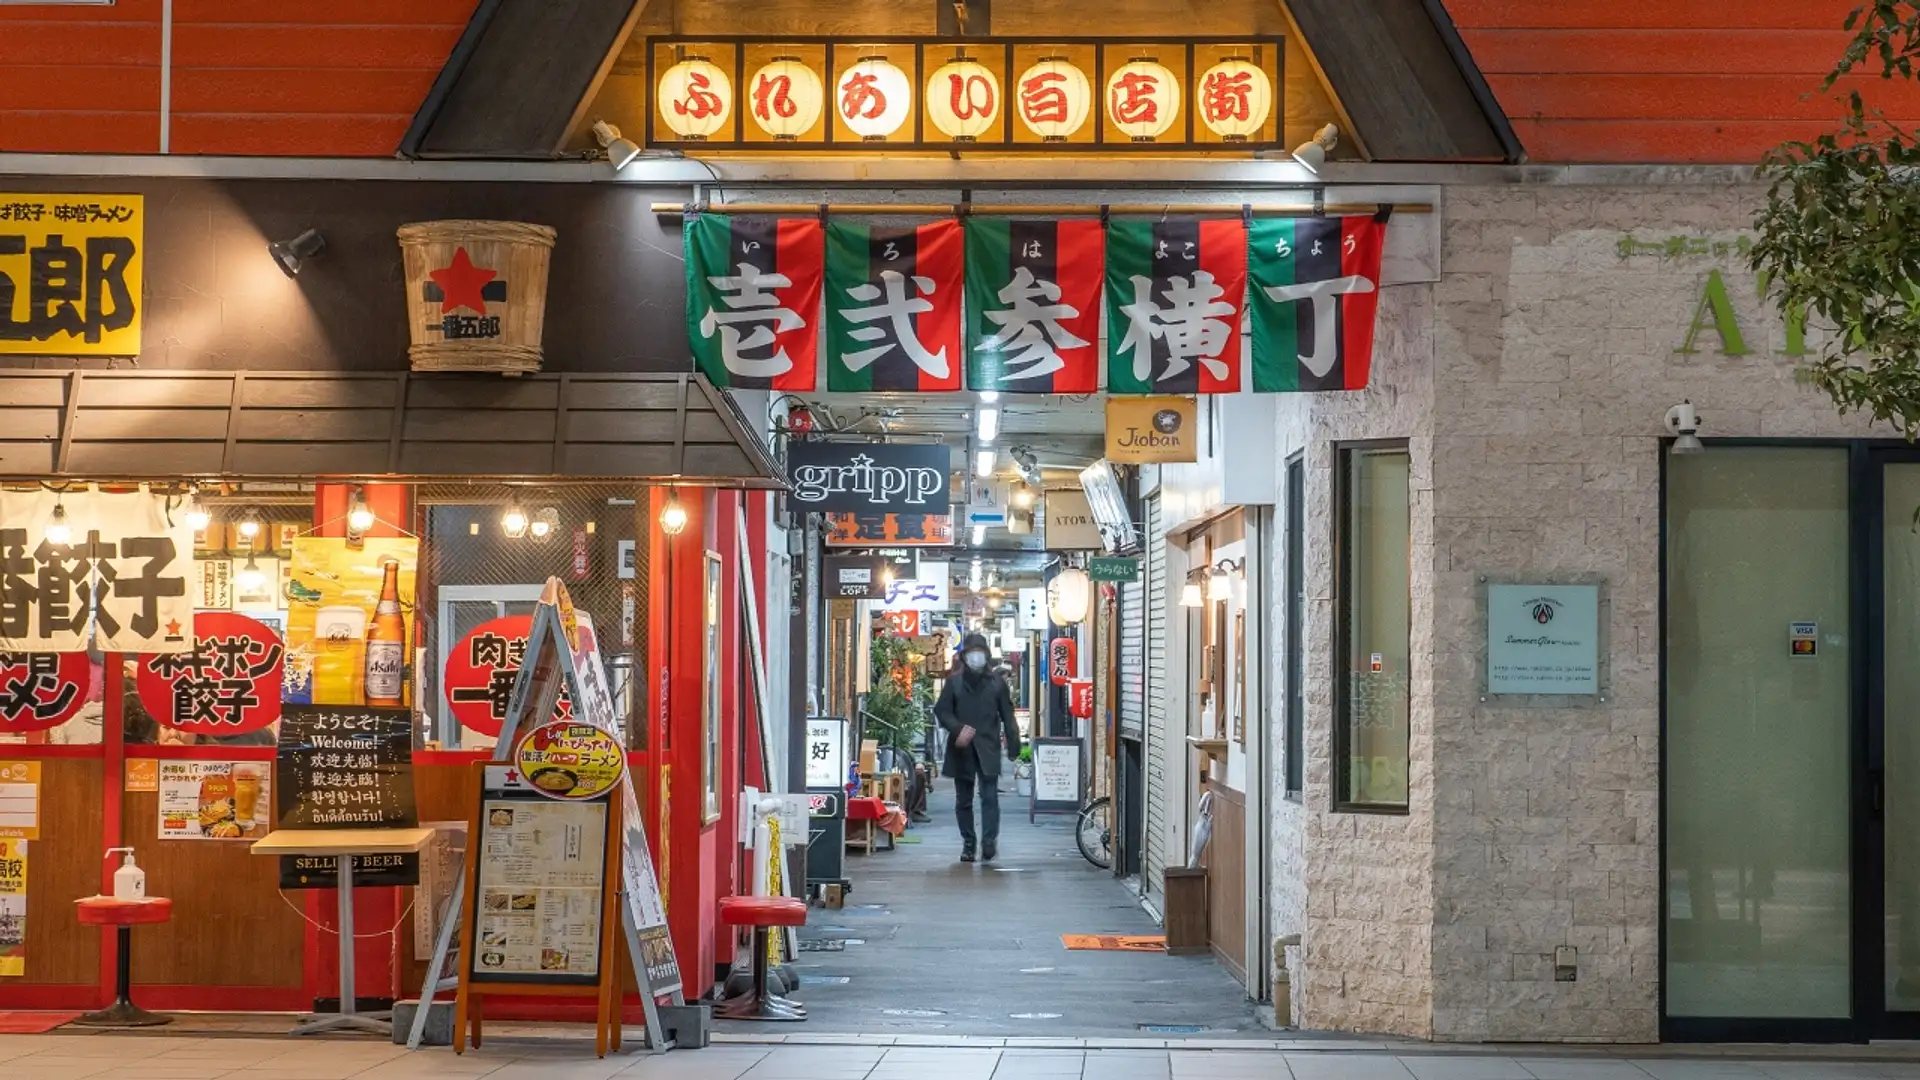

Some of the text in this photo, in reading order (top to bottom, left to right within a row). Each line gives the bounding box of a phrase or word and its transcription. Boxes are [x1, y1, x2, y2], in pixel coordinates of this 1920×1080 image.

[426, 315, 500, 339] 一番五郎
[1117, 427, 1181, 447] Jioban
[794, 455, 943, 503] gripp
[1094, 564, 1134, 576] うらない
[1796, 627, 1814, 635] VISA
[369, 660, 399, 674] Asahi
[172, 675, 259, 725] 餃子
[313, 713, 380, 730] ようこそ!
[310, 734, 379, 750] Welcome!
[811, 741, 831, 760] 好
[310, 754, 379, 769] 欢迎光临!
[580, 753, 620, 767] ラーメン
[296, 855, 404, 869] SELLIG BEER
